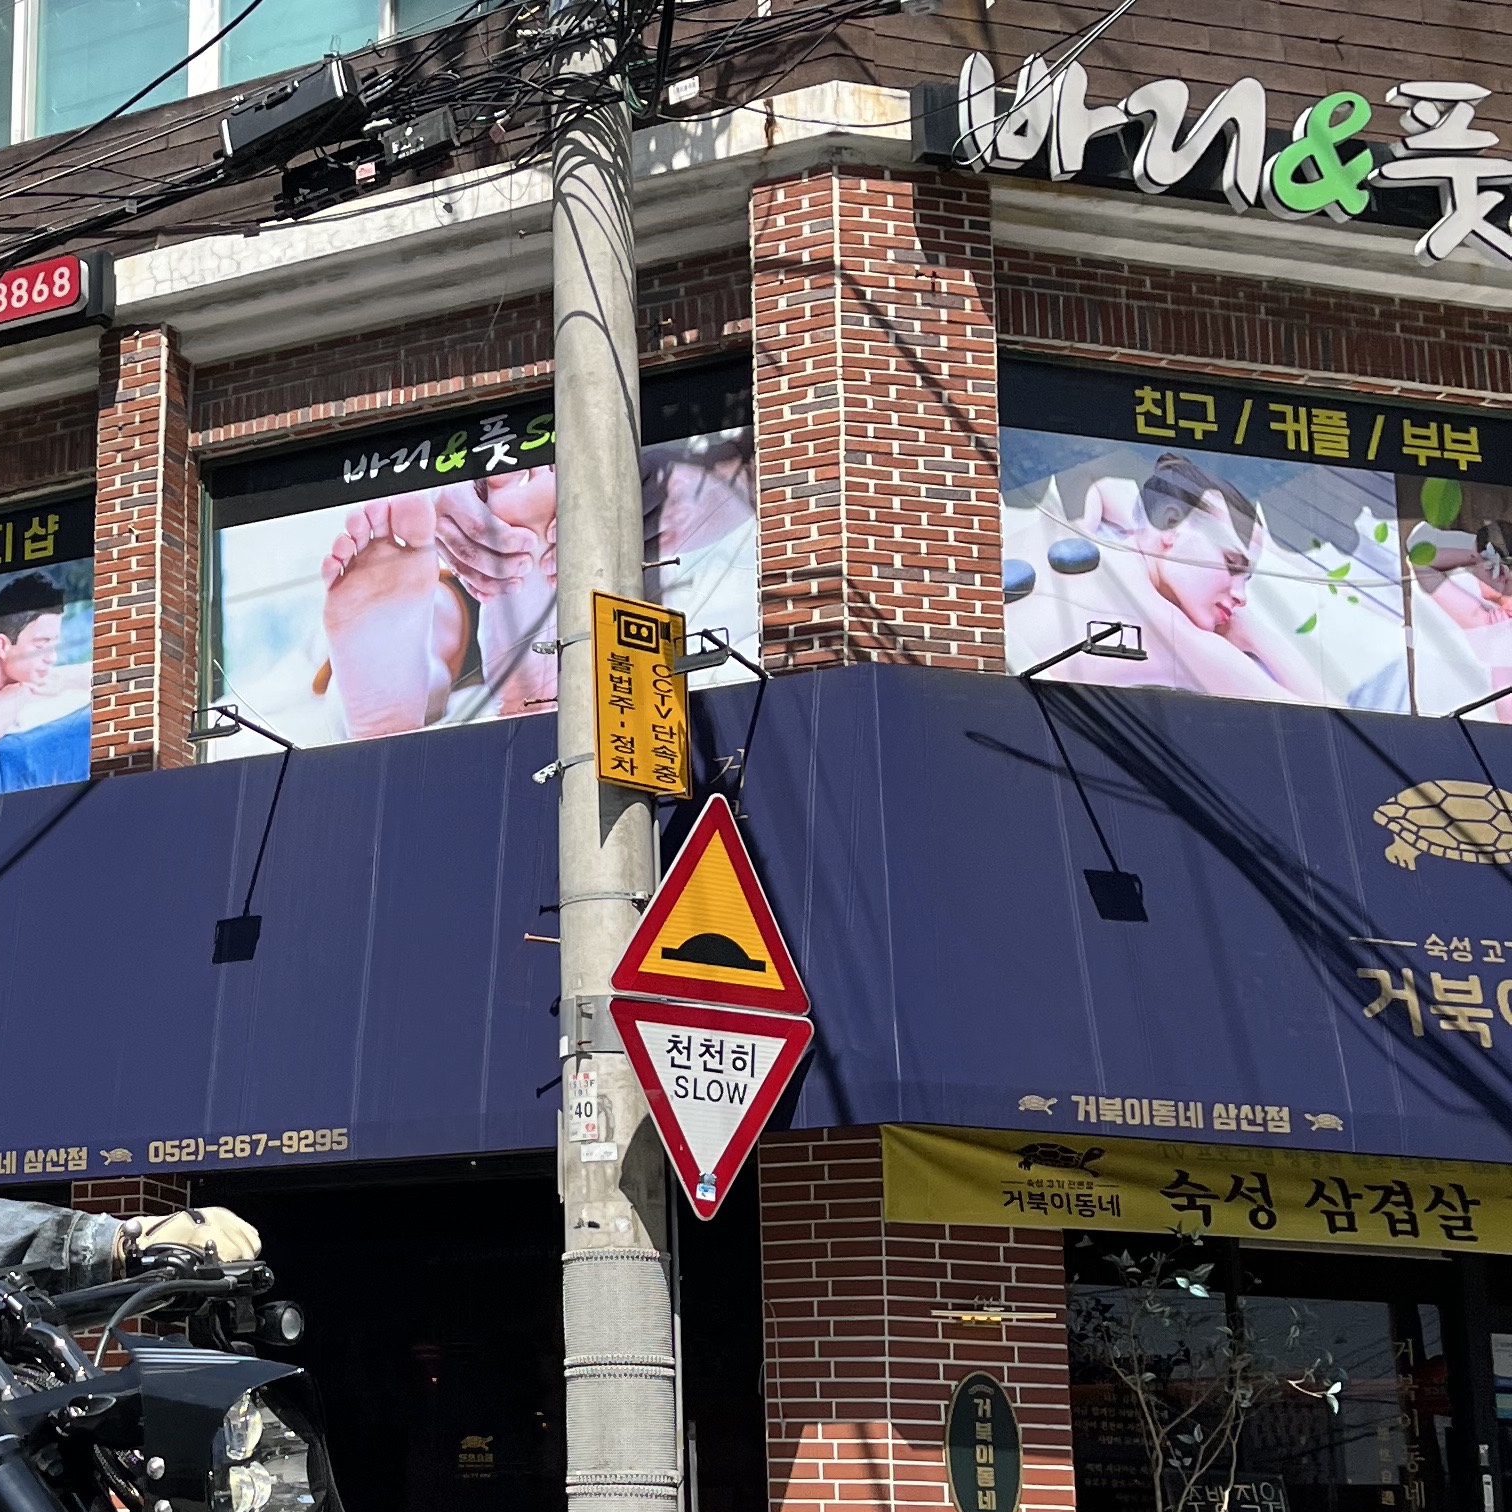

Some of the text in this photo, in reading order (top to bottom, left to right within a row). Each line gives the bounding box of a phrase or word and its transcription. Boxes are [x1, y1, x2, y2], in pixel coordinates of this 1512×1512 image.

[1134, 385, 1219, 441] 친구
[1269, 403, 1351, 460] 커플
[1402, 418, 1483, 471] 부부
[24, 514, 60, 561] 샵
[1423, 933, 1473, 963] 숙성
[666, 1034, 757, 1078] 천천히
[574, 1101, 593, 1119] 40
[673, 1075, 748, 1106] SLOW
[1070, 1095, 1292, 1134] 거북이동네 삼산점
[24, 1145, 88, 1173] 삼산점
[148, 1128, 349, 1165] 052)-267-9295
[1002, 1190, 1121, 1218] 거북이동네
[1160, 1169, 1481, 1242] 숙성 삼겹살
